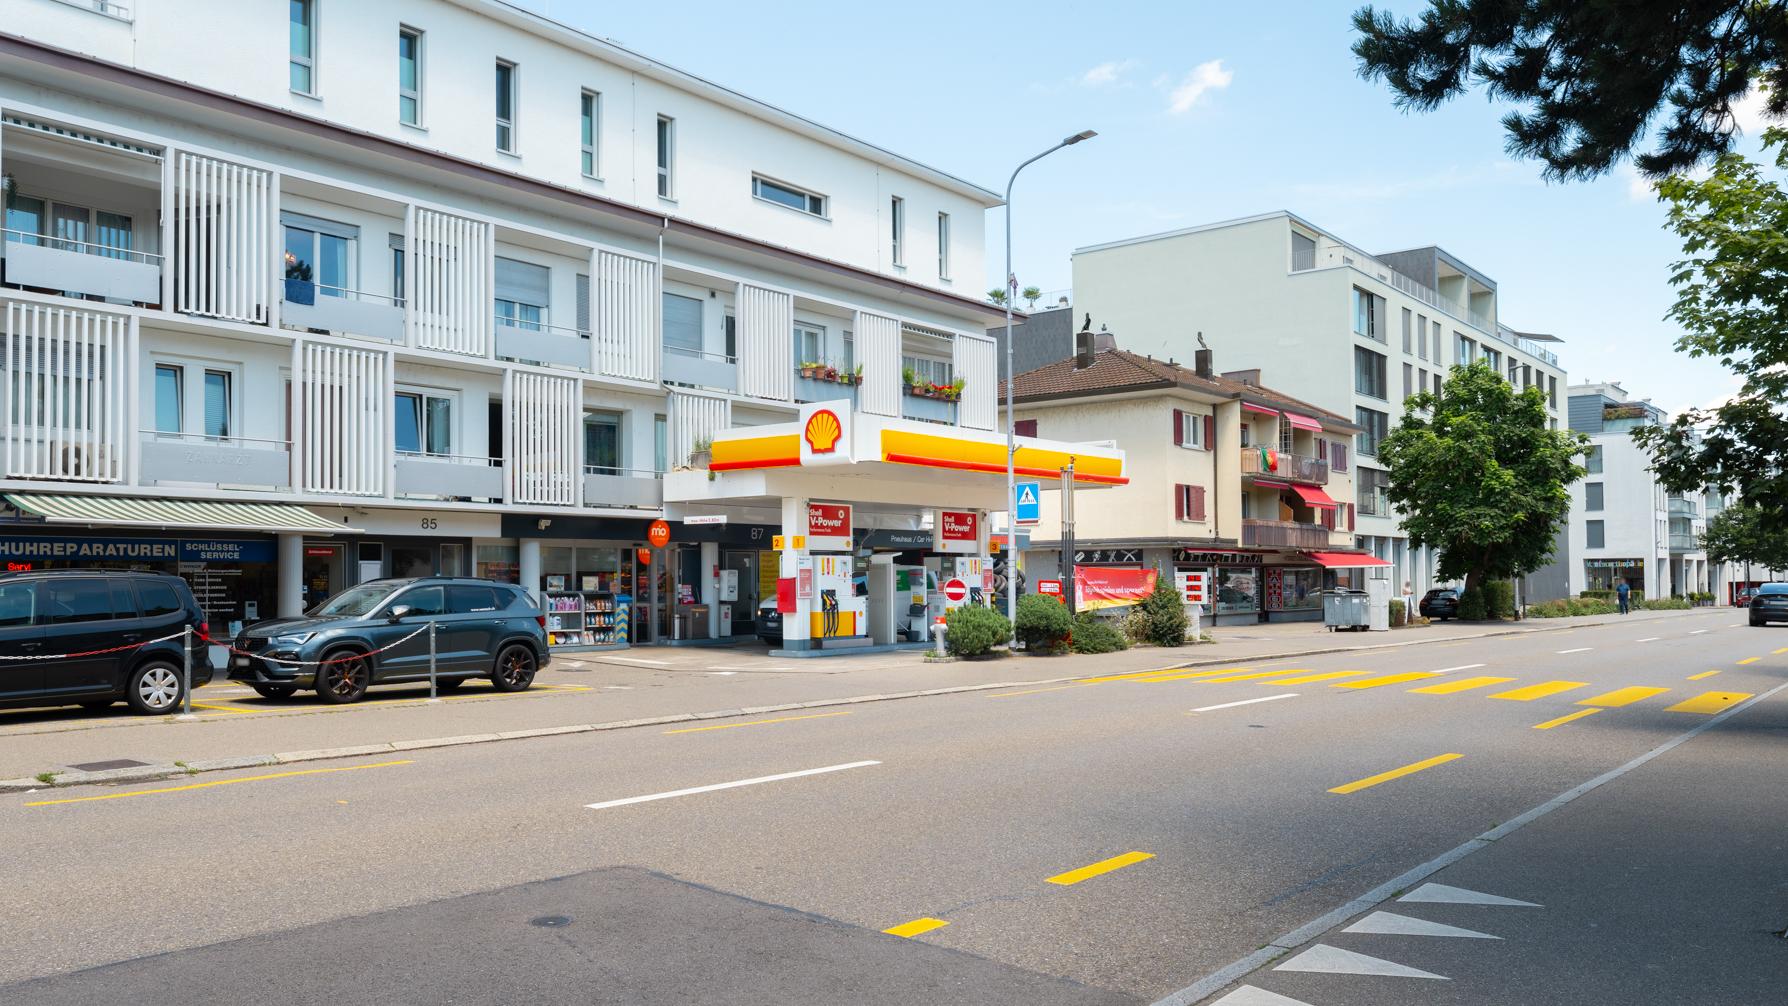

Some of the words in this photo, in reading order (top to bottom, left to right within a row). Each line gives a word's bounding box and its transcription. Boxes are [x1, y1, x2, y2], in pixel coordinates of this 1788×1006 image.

[421, 517, 437, 529] 85
[810, 516, 842, 527] V-Power
[944, 522, 970, 531] V-Power
[751, 528, 764, 540] 87
[185, 541, 244, 552] SCHLÜSSEL-
[774, 539, 780, 547] 2
[991, 543, 998, 551] 3
[200, 551, 240, 559] SERVICE
